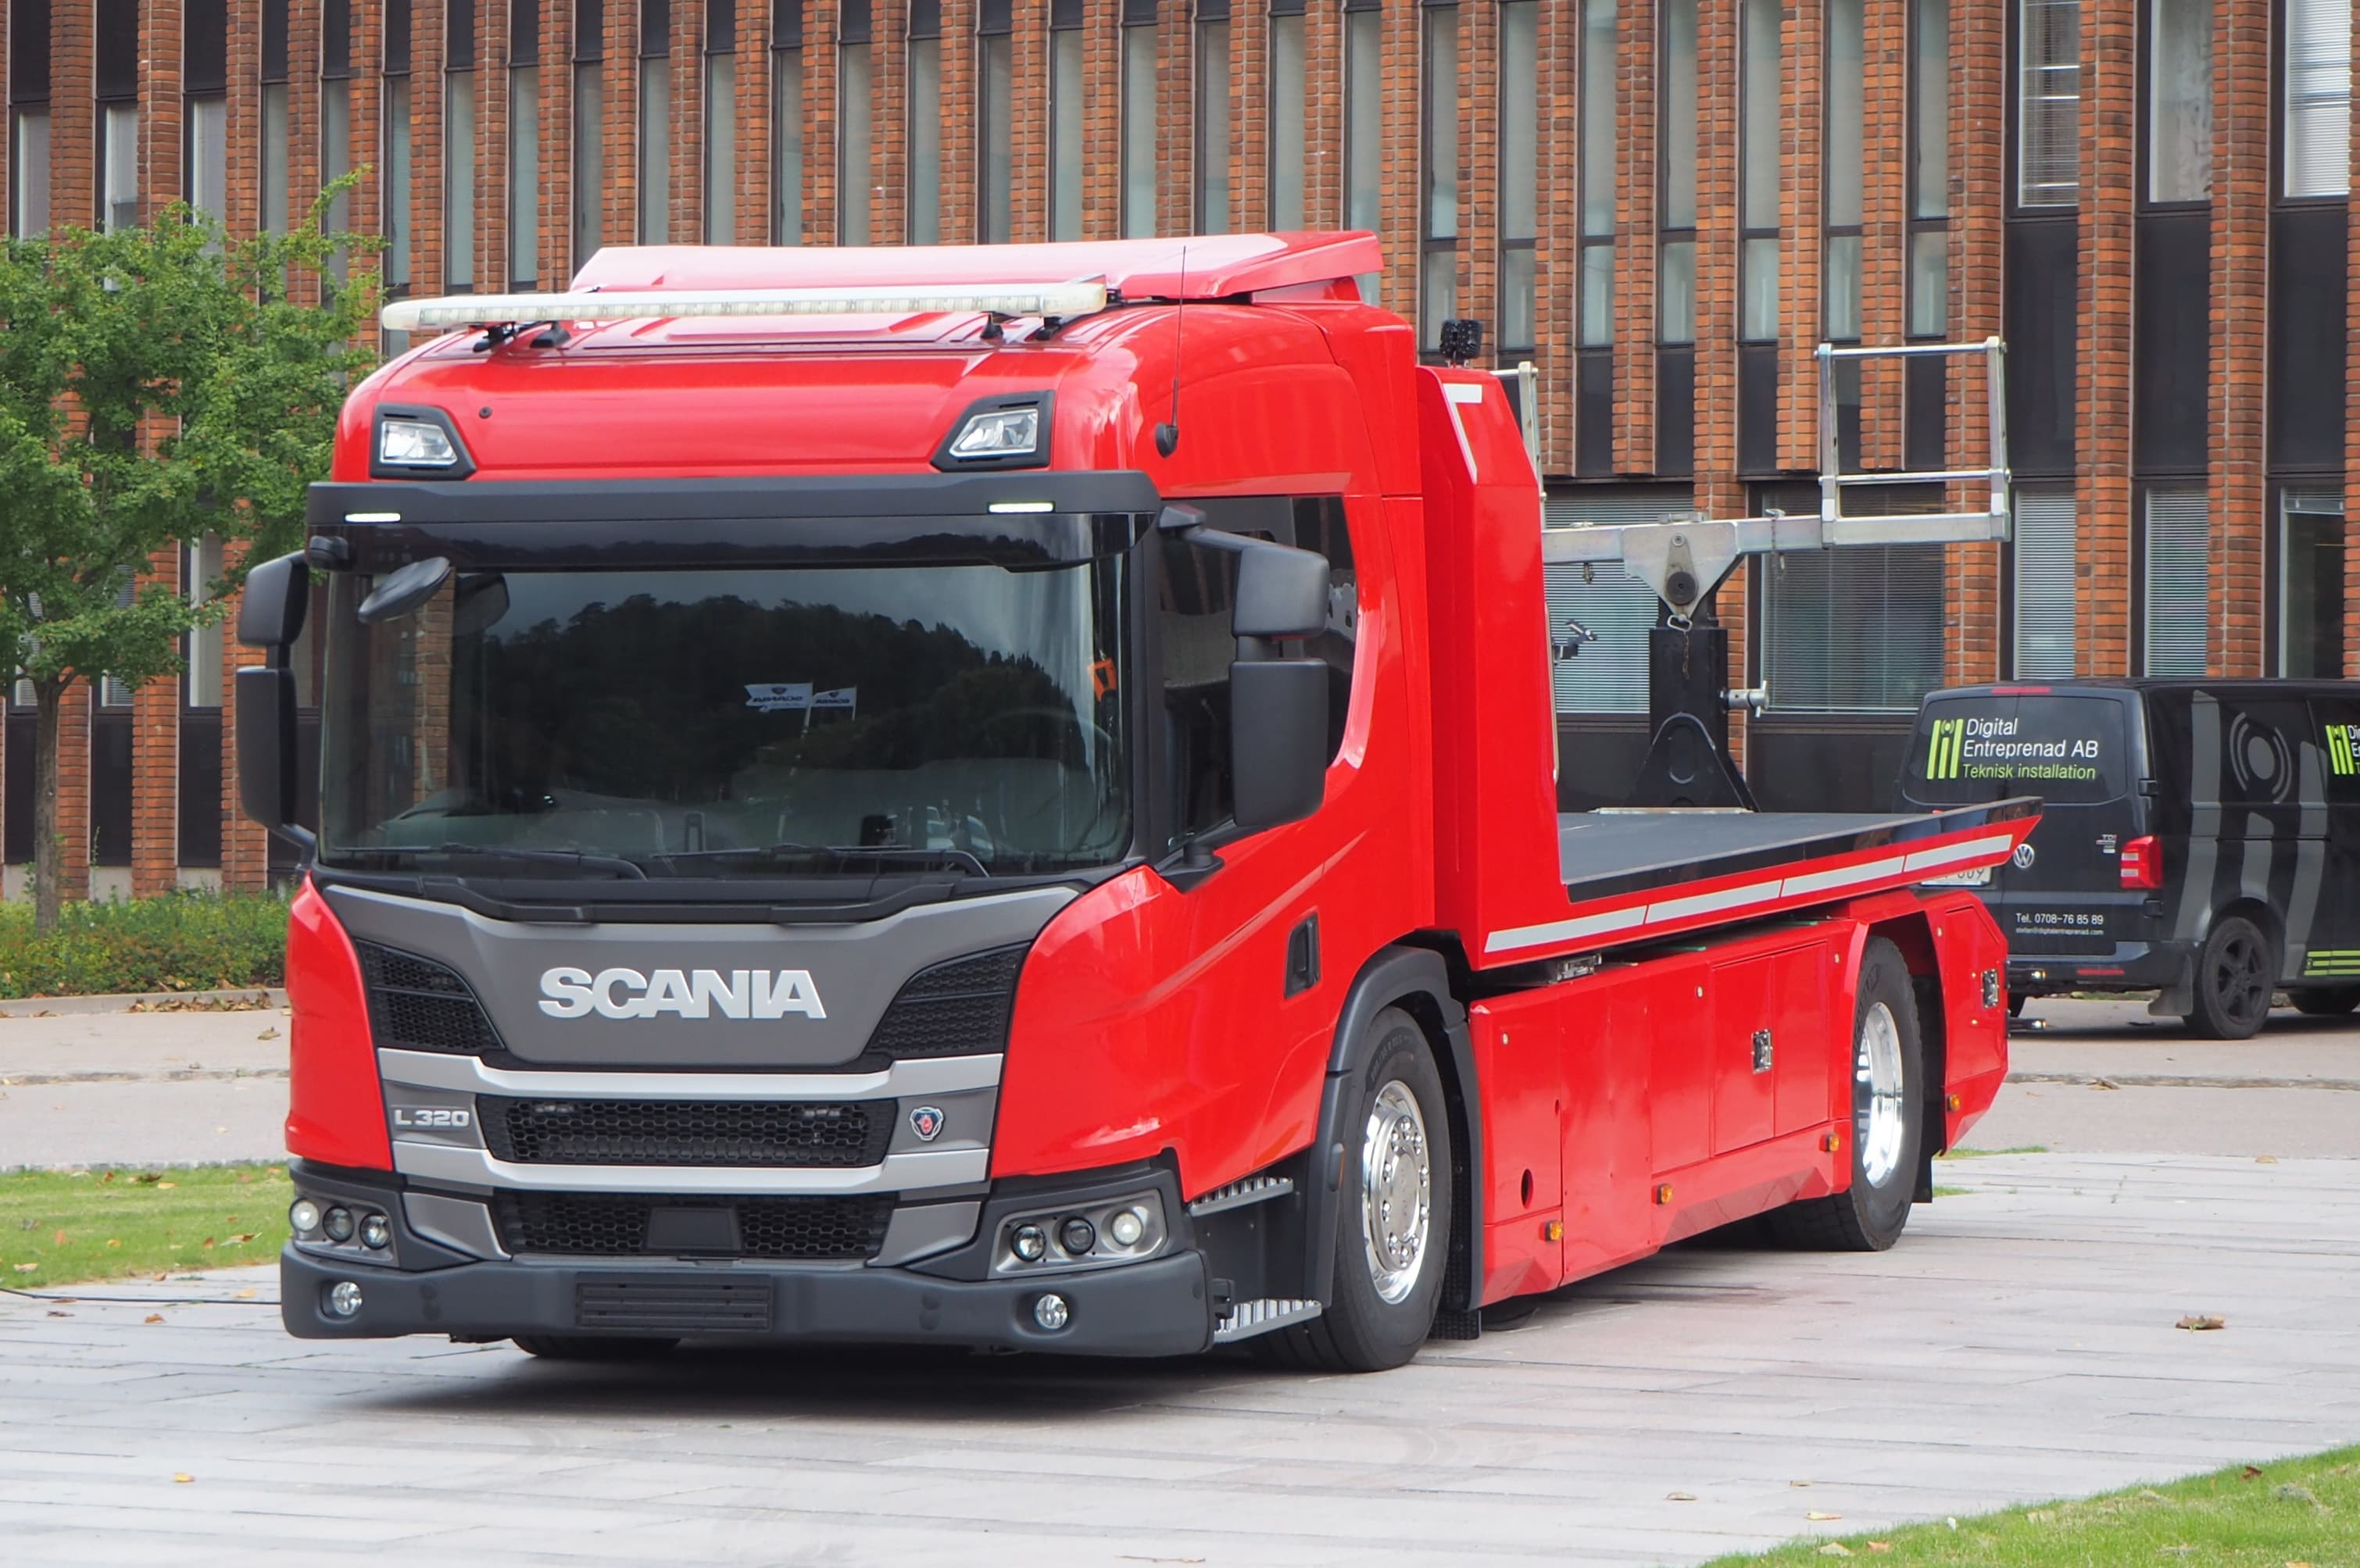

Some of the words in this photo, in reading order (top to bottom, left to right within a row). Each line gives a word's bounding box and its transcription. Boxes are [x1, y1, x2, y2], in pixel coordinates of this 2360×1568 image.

[1966, 718, 2019, 738] Digital
[1963, 739, 2066, 759] Entreprenad
[2071, 740, 2098, 758] AB
[1962, 763, 2013, 778] Teknisk
[2018, 764, 2096, 780] installation
[2015, 913, 2032, 923] Tel.
[2034, 913, 2075, 924] 0708-76
[2076, 914, 2089, 924] 85
[2091, 915, 2104, 925] 89
[538, 966, 827, 1020] SCANIA
[395, 1109, 412, 1126] L
[415, 1110, 470, 1127] 320
